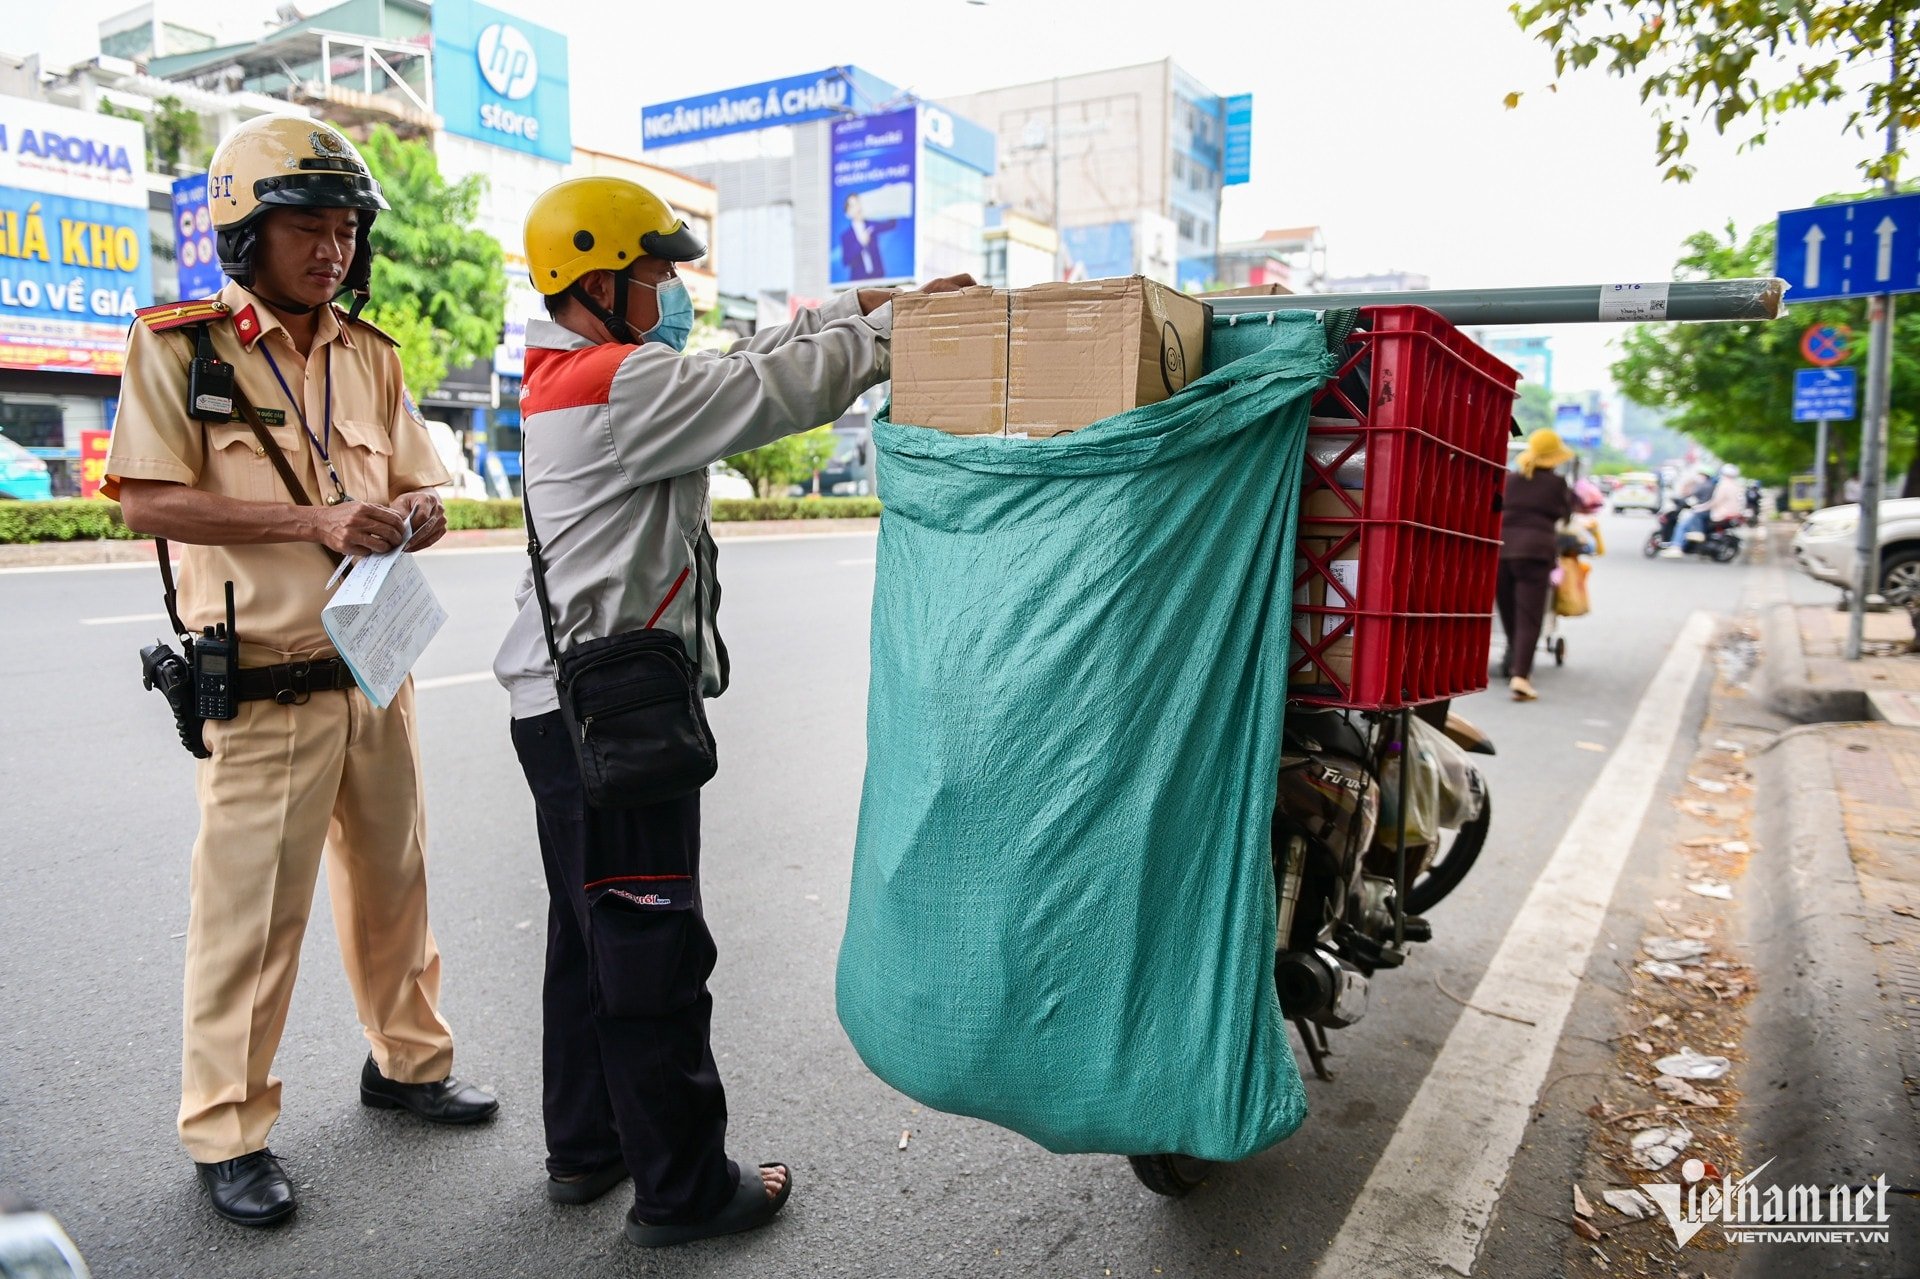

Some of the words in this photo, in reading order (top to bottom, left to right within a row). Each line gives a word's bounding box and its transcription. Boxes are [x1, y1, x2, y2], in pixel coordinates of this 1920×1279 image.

[480, 102, 539, 141] store
[644, 105, 700, 140] NGÂN
[701, 96, 763, 129] HÀNG
[764, 86, 783, 118] Á
[781, 78, 847, 115] CHÂU
[19, 128, 132, 174] AROMA
[60, 217, 140, 272] KHO
[1, 278, 41, 308] LO
[45, 276, 87, 313] VỀ
[90, 286, 140, 317] GIÁ
